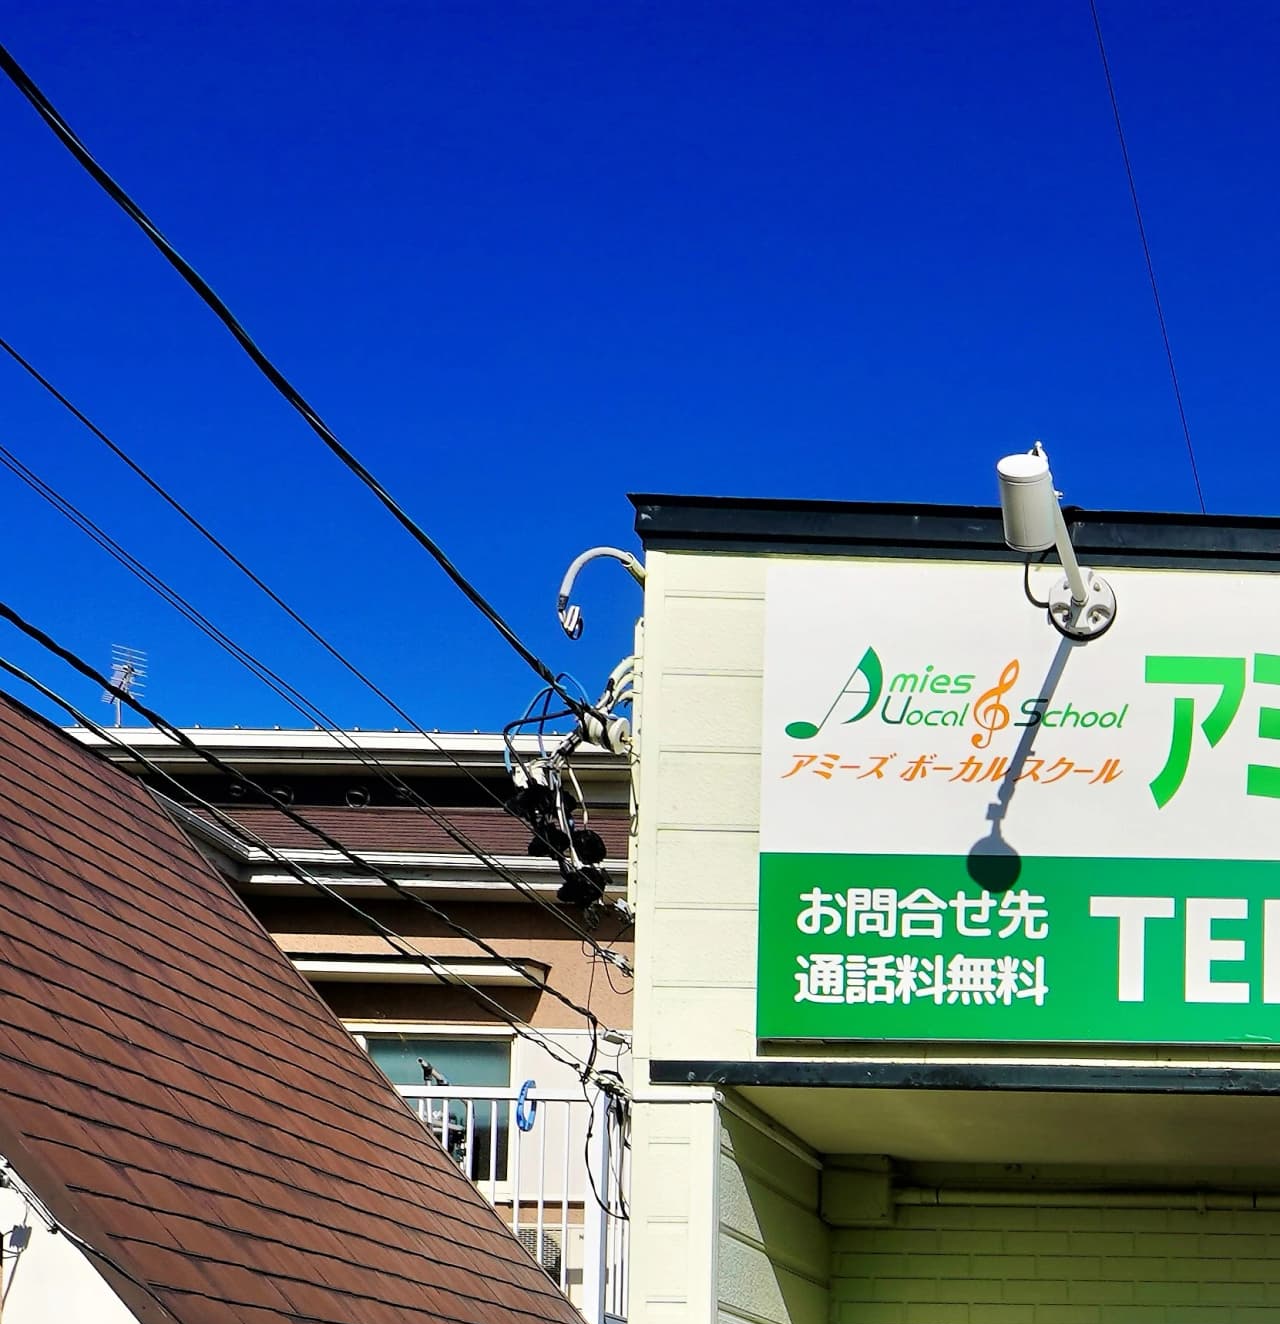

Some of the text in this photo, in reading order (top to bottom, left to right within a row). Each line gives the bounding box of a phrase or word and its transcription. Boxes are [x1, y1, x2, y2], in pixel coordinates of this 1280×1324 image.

[785, 646, 976, 740] Amies
[1014, 699, 1129, 729] School
[796, 886, 1049, 940] お問合せ先
[793, 953, 1049, 1006] 通話料無料
